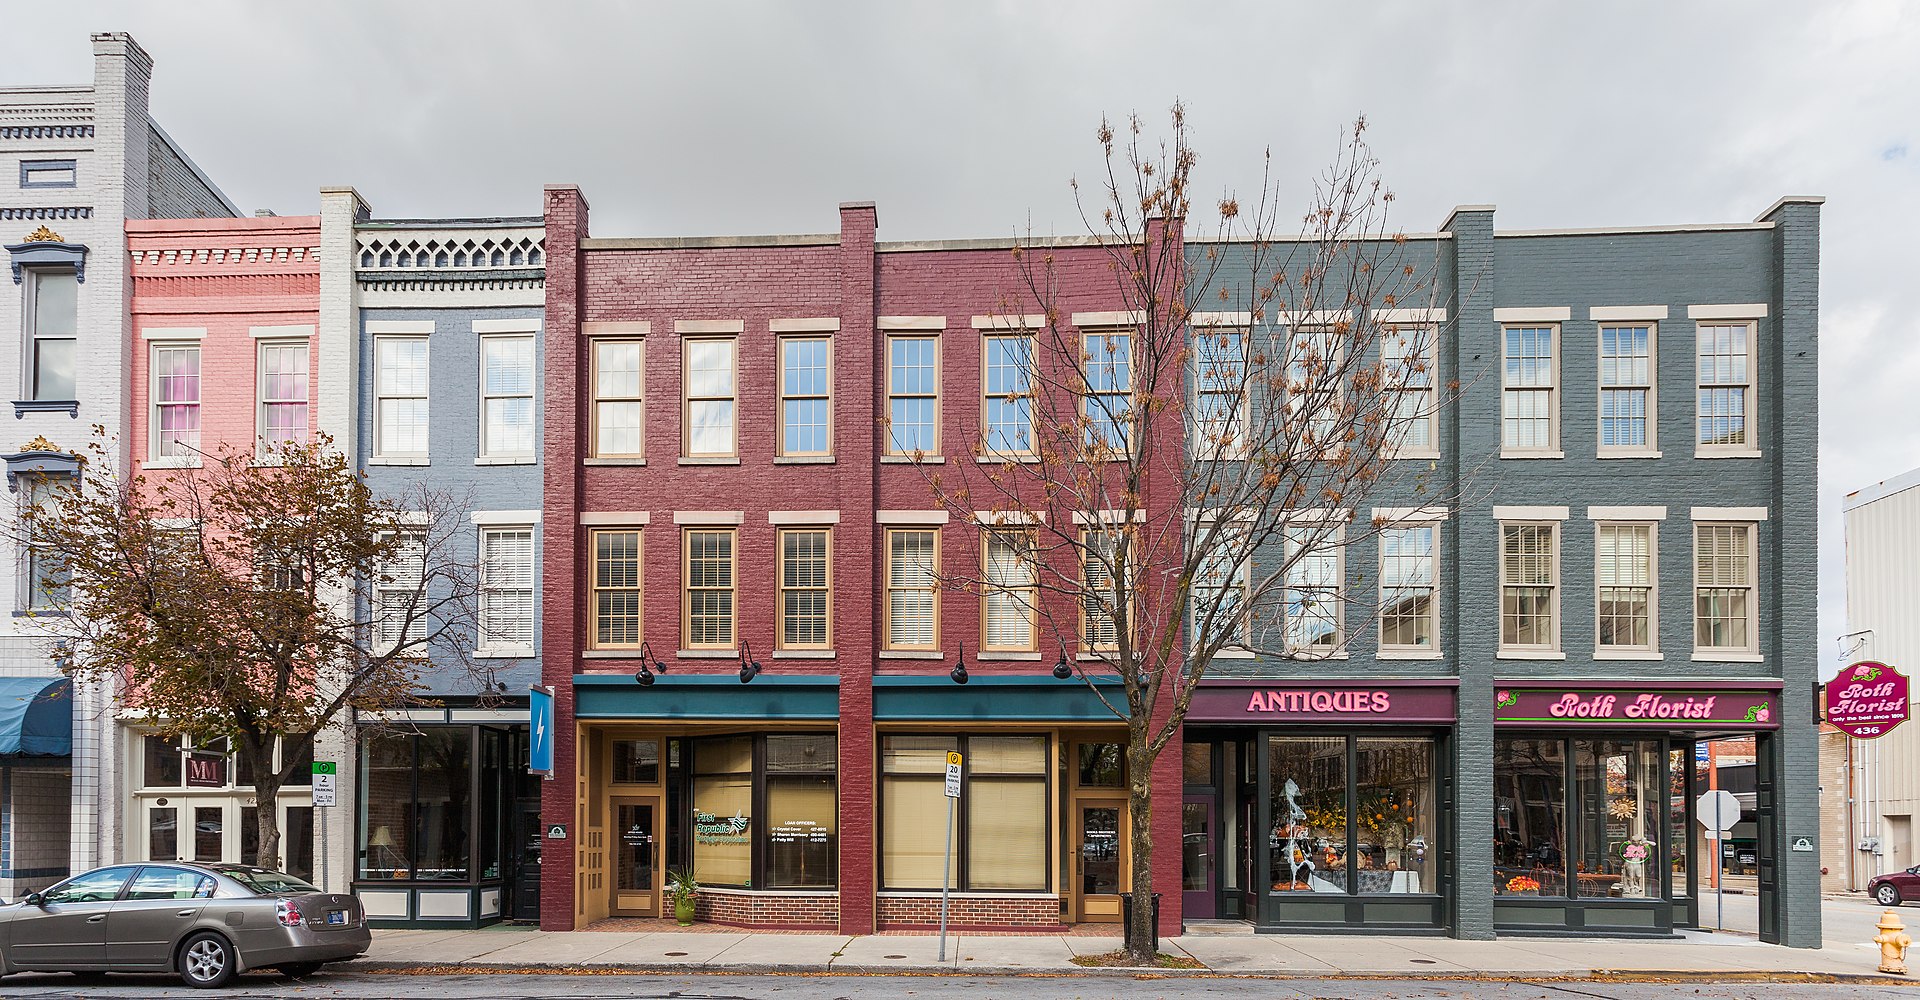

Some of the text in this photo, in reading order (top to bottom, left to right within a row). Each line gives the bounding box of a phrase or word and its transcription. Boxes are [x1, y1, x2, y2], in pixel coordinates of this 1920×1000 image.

[1839, 683, 1895, 698] Roth
[1247, 691, 1390, 713] ANTIQUES
[1550, 693, 1716, 718] Roth Florist
[1828, 697, 1906, 714] Florist
[190, 760, 217, 780] MM
[950, 765, 958, 774] 20
[321, 775, 327, 783] 2
[697, 812, 715, 822] First
[697, 823, 730, 834] Republic
